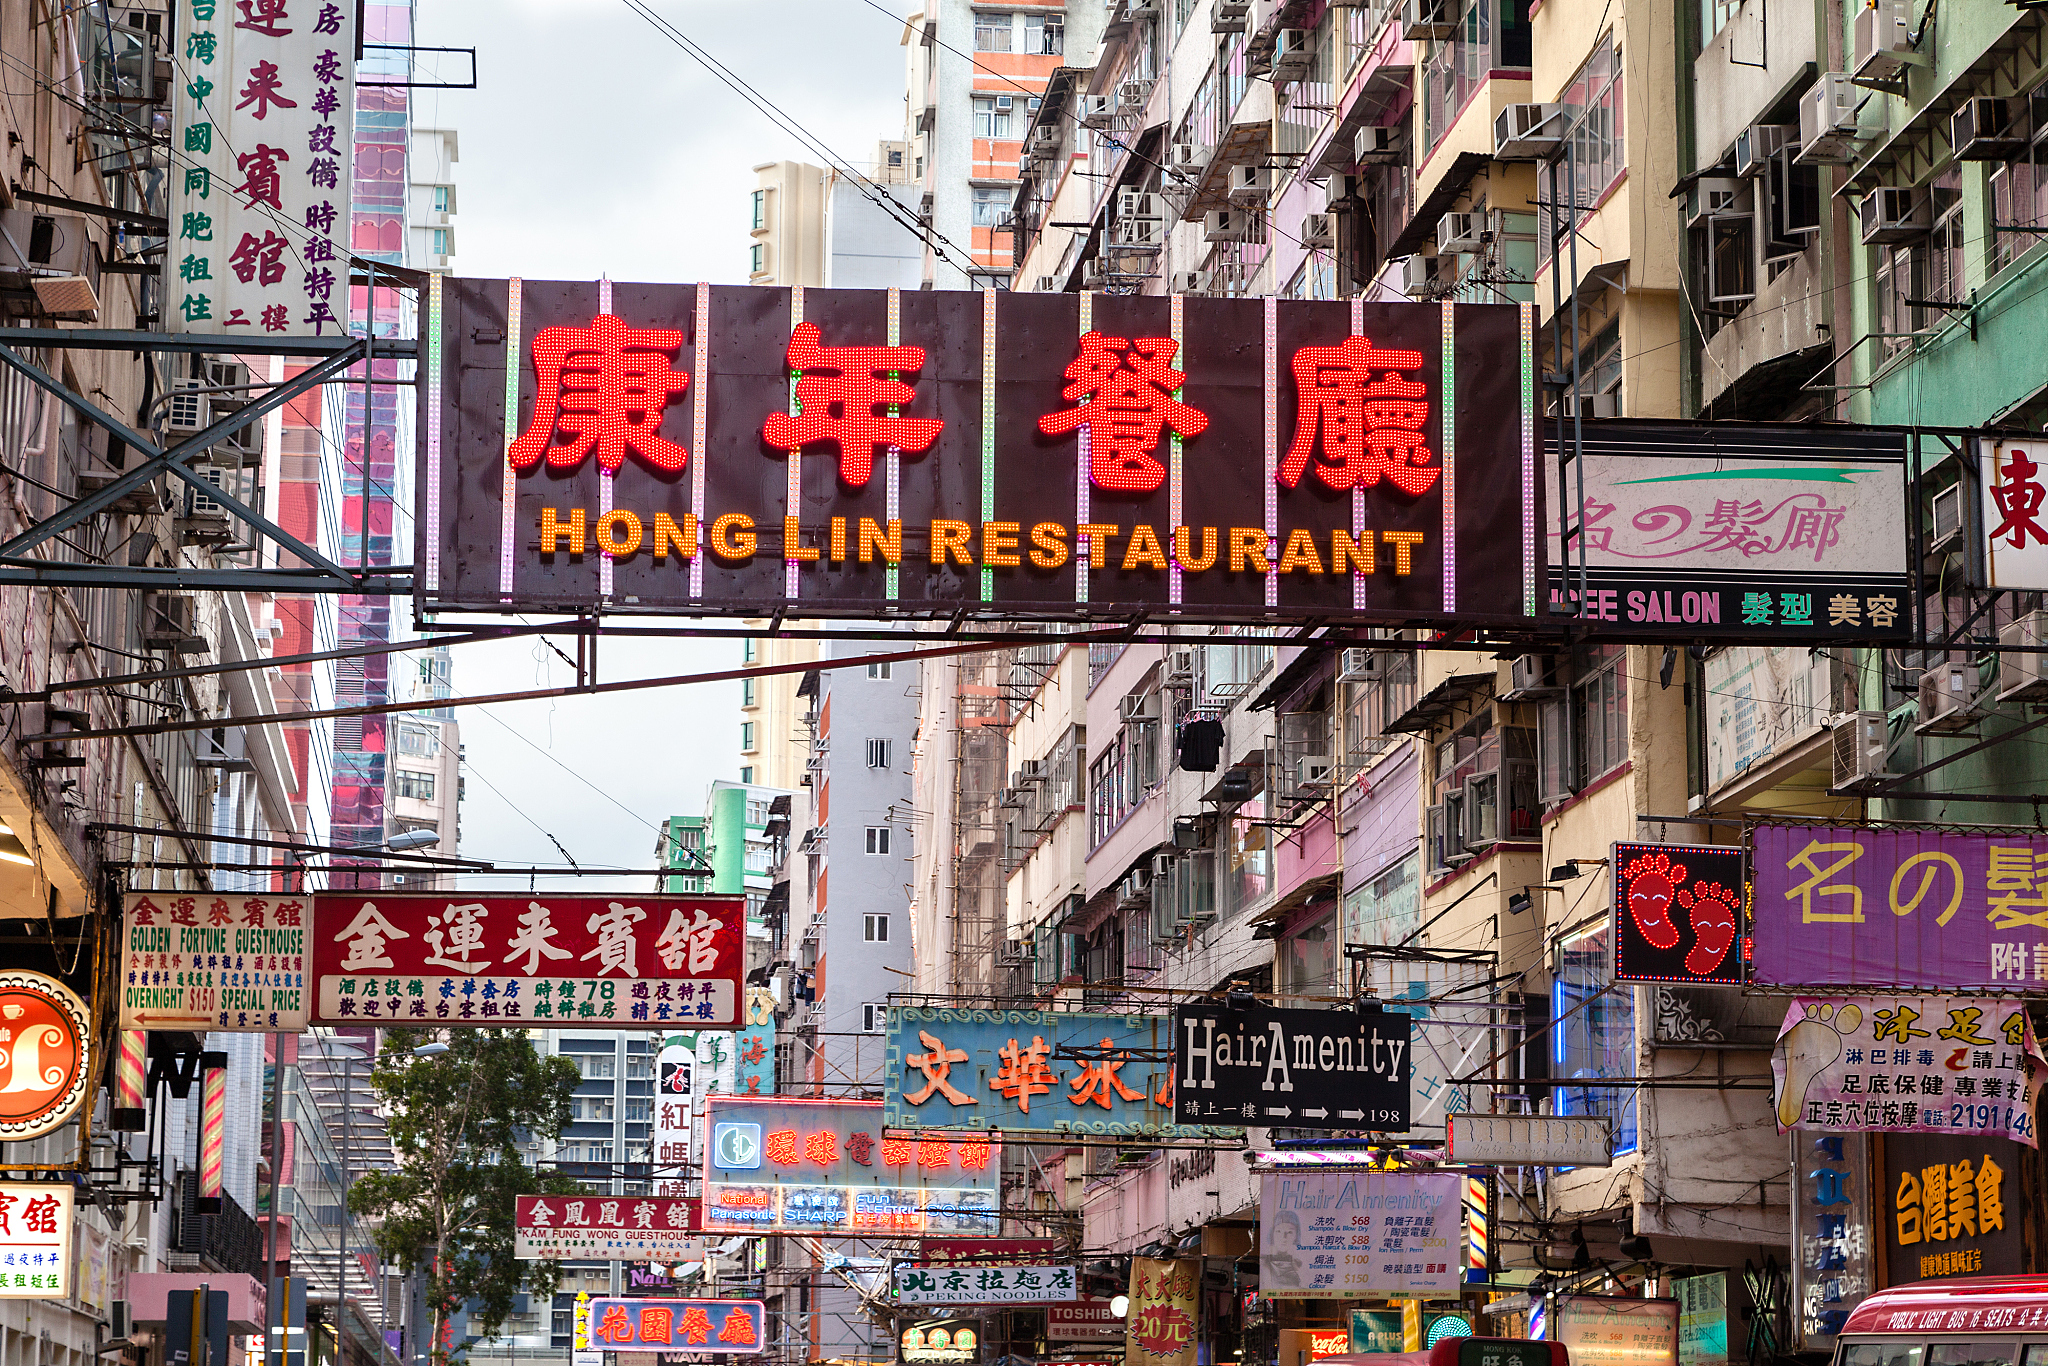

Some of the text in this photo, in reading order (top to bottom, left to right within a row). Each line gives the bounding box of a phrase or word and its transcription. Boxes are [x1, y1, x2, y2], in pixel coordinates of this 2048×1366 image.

[224, 304, 290, 333] 二樓
[1989, 450, 2048, 549] 東
[541, 507, 1424, 576] HONG LIN RESTAURANT
[1627, 590, 1720, 623] SALON
[1742, 592, 1898, 628] 髮型 美容
[131, 927, 303, 954] GOLDEN FORTUNE GUESTHOUSE
[254, 956, 302, 971] 酒店設備
[338, 978, 424, 997] 酒店設備
[439, 978, 521, 999] 豪華套房
[631, 981, 716, 1001] 過夜特平
[127, 988, 300, 1012] OVERNIGHT $150 SPECIAL PRICE
[533, 1001, 617, 1019] 純粹租房
[631, 1001, 715, 1020] 請登二樓
[1846, 1049, 1935, 1066] 淋巴排毒
[902, 1030, 1175, 1114] 文華冰
[1841, 1074, 1944, 1096] 足底保健
[1185, 1100, 1400, 1122] 請上一樓 198
[1806, 1101, 1918, 1128] 正宗穴位按摩
[1951, 1103, 1999, 1129] 2191
[721, 1194, 768, 1206] National
[1897, 1154, 2005, 1245] 台灣美食
[710, 1207, 777, 1220] Panasonic
[783, 1209, 848, 1222] SHARP
[855, 1204, 921, 1215] ELECTRIC
[1351, 1216, 1370, 1226] $68
[522, 1229, 697, 1240] KAM FUNG WONG GUESTHOUSE
[1351, 1235, 1370, 1245] $88
[1422, 1238, 1447, 1247] $200
[1345, 1254, 1369, 1264] $100
[1344, 1273, 1369, 1284] $150
[926, 1291, 985, 1300] PEKING
[991, 1290, 1067, 1300] NOODLES
[596, 1305, 757, 1345] 花園餐廳
[1138, 1314, 1188, 1342] 20元
[1887, 1312, 1918, 1329] PUBLIC
[1919, 1311, 1947, 1328] LIGHT
[1947, 1311, 1967, 1328] BUS
[1969, 1310, 1982, 1328] 16
[1984, 1309, 2016, 1327] SEATS
[1610, 1333, 1623, 1341] $68
[663, 1353, 714, 1363] WAVE
